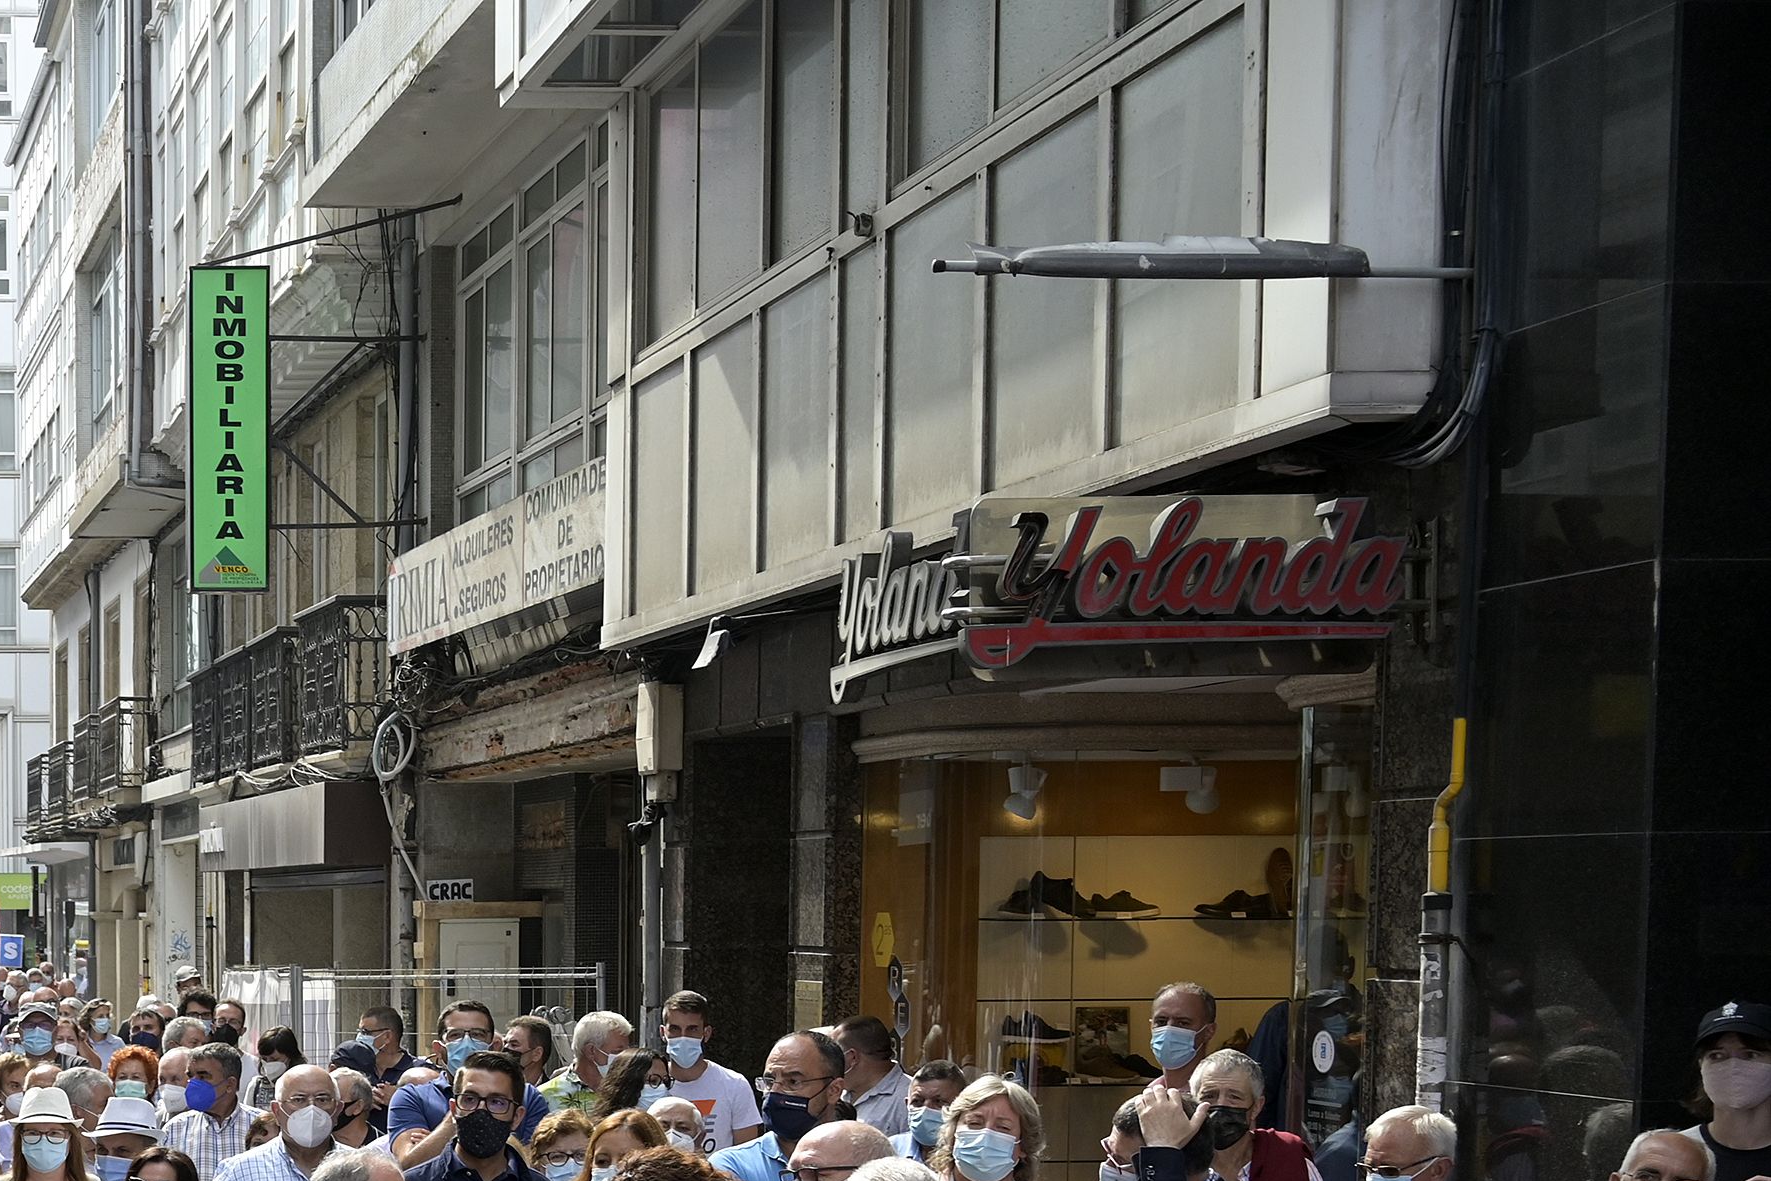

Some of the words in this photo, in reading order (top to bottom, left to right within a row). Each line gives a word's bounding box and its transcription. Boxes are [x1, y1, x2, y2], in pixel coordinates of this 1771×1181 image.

[213, 272, 246, 539] INMOBILIARIA
[453, 515, 514, 570] ALQUILERES
[557, 514, 574, 550] DE
[458, 572, 507, 616] SEGUROS
[963, 496, 1406, 666] Yolanda
[830, 508, 973, 704] Yoland
[0, 883, 34, 894] coder
[429, 881, 473, 901] CRAC
[3, 942, 19, 960] S
